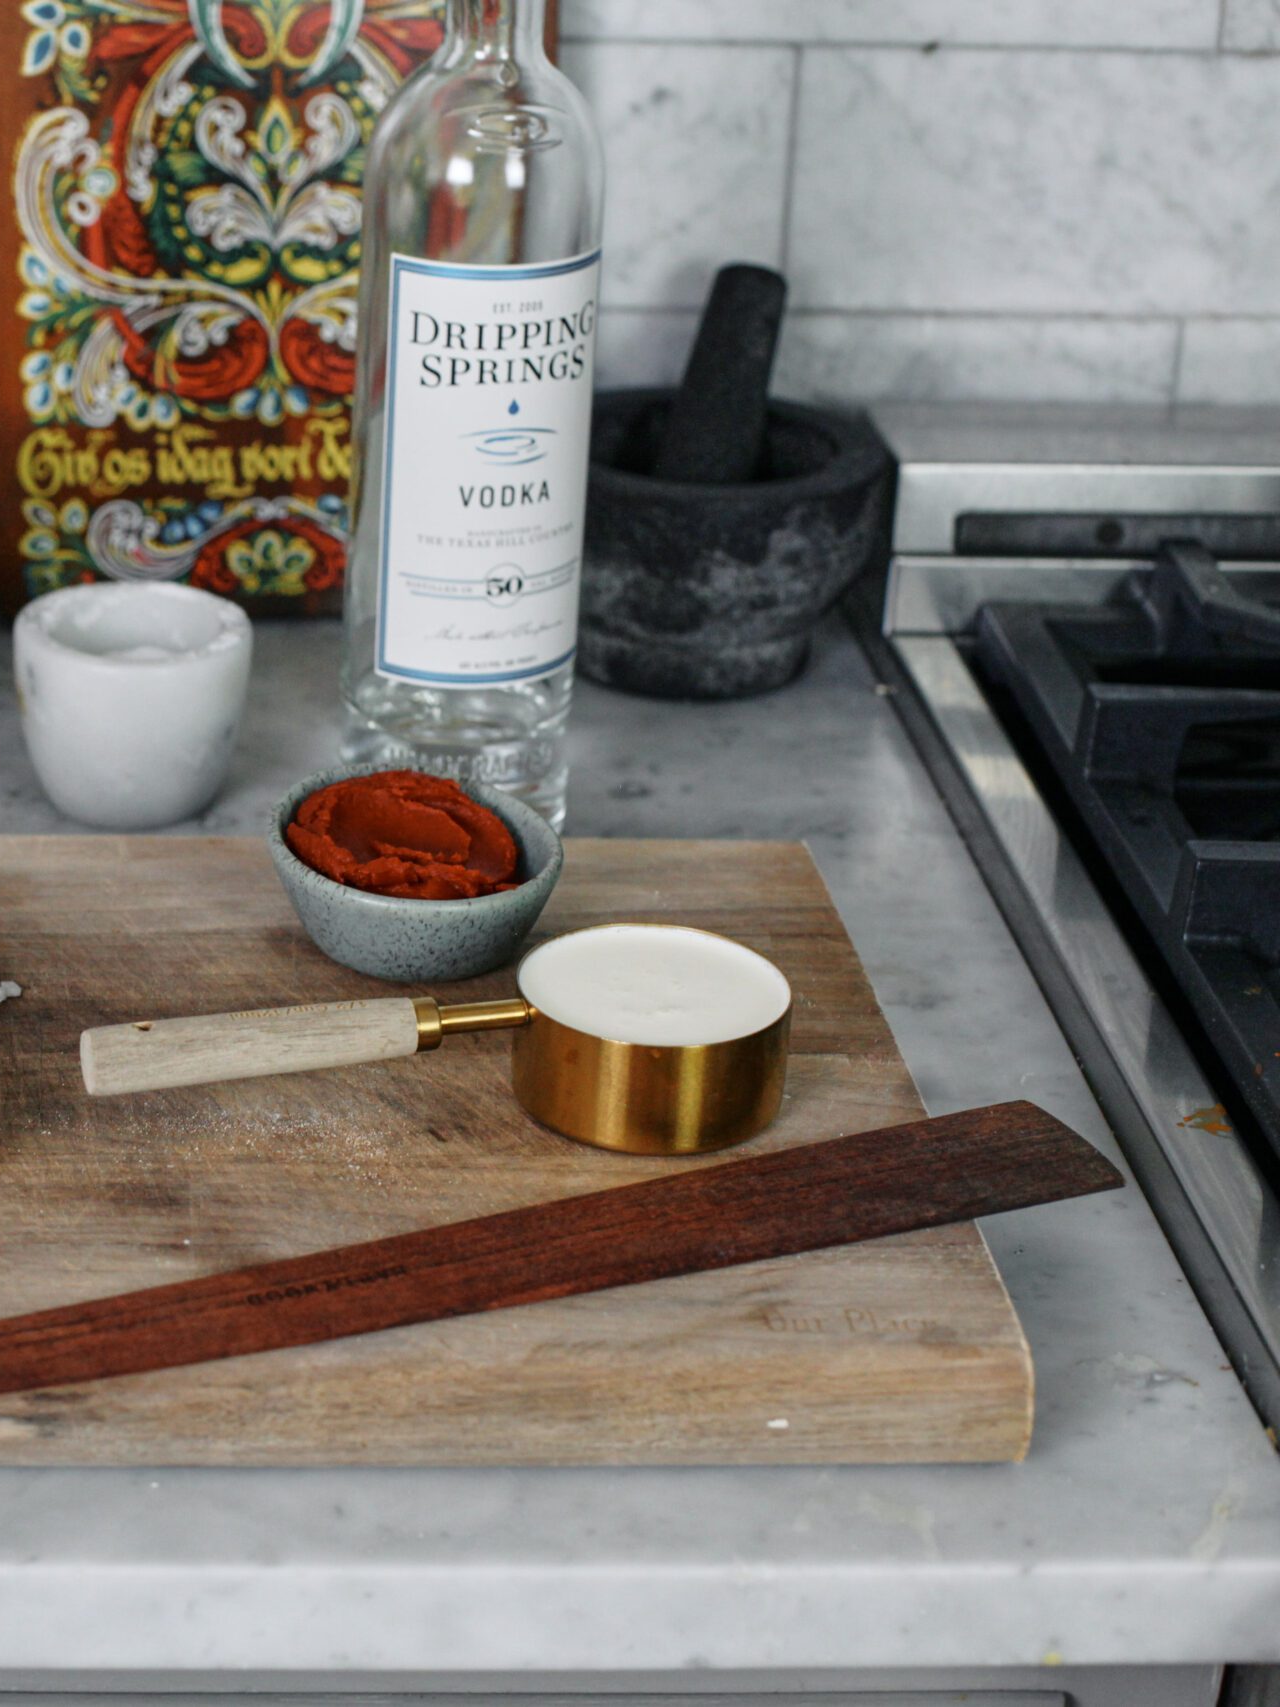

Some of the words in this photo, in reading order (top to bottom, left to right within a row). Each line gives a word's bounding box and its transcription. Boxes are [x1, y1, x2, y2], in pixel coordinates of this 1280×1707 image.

[410, 300, 595, 351] DRIPPING
[420, 343, 586, 389] SPRINGS
[459, 480, 551, 509] VODKA
[486, 576, 524, 598] 50
